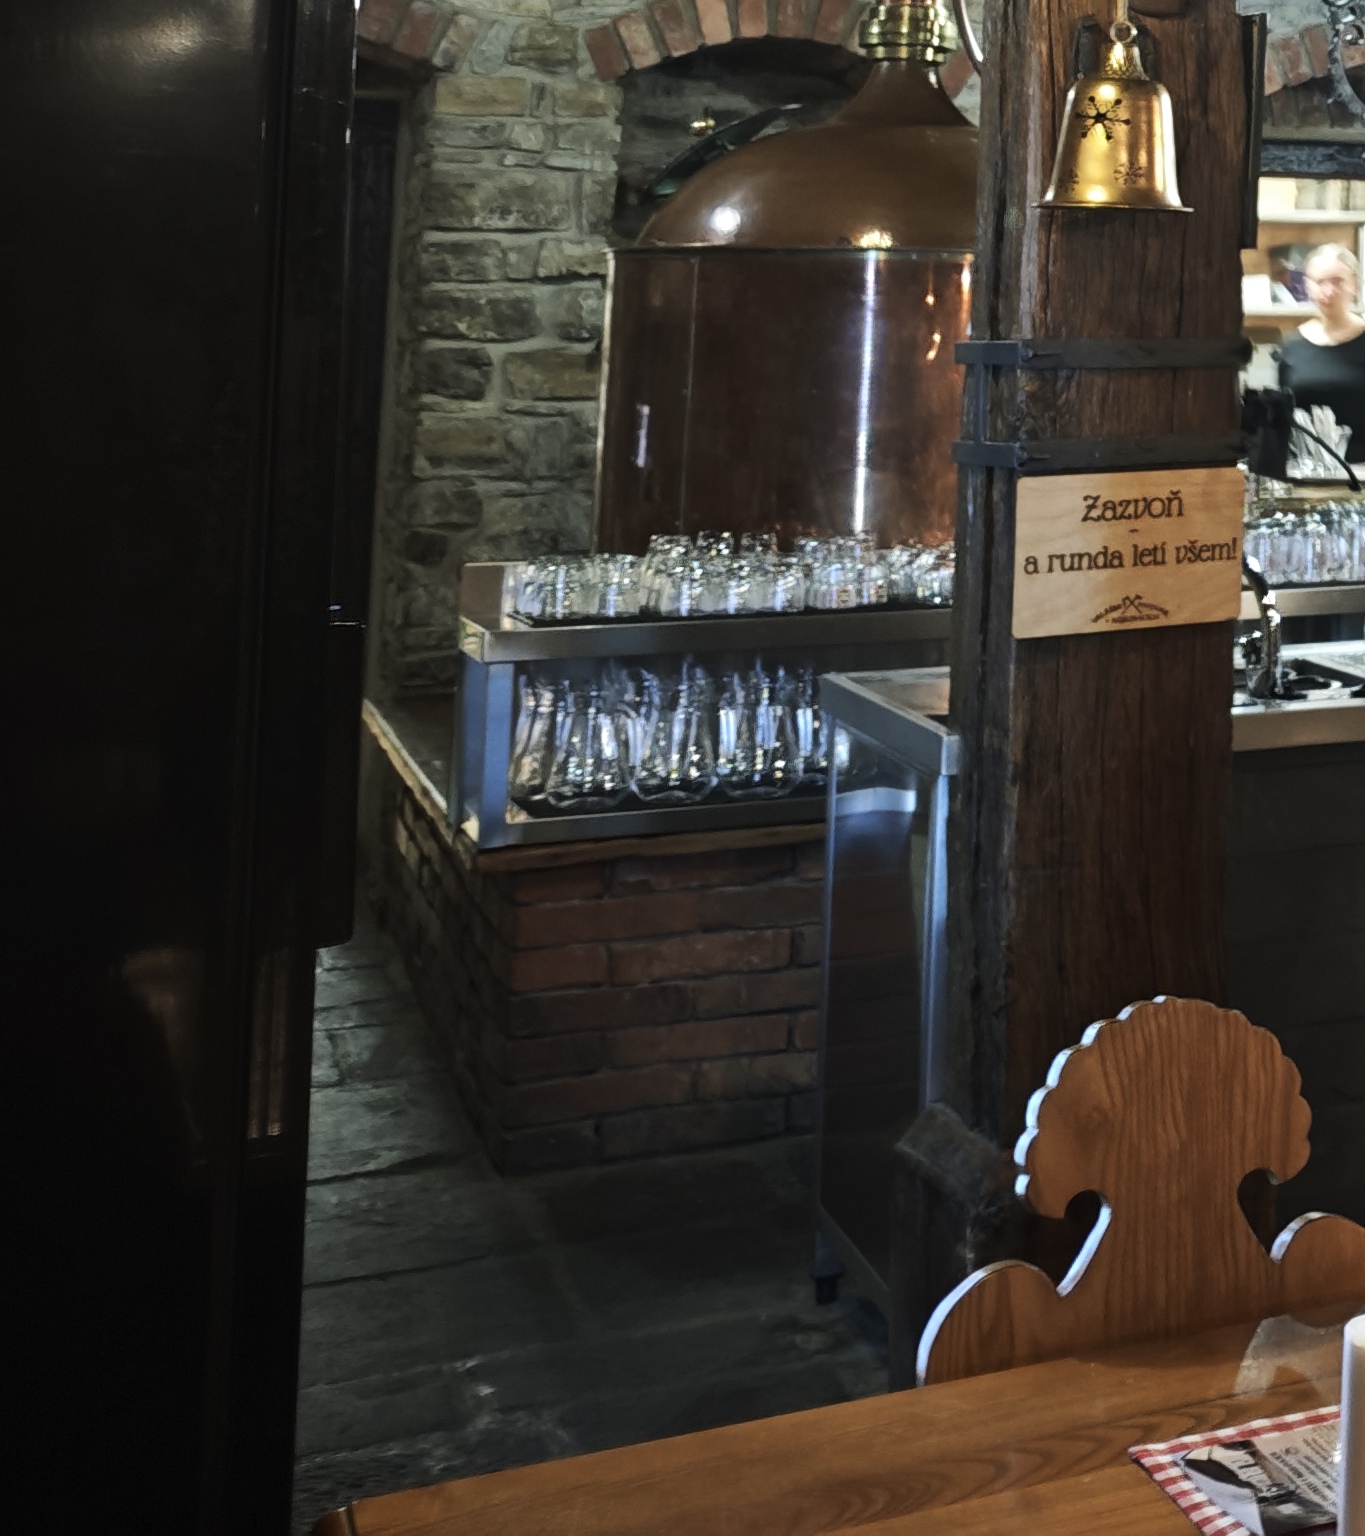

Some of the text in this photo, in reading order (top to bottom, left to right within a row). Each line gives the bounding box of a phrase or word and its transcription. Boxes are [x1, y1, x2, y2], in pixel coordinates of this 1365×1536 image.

[1080, 489, 1185, 523] Zazvoň
[1023, 536, 1238, 576] a runda letí všem!
